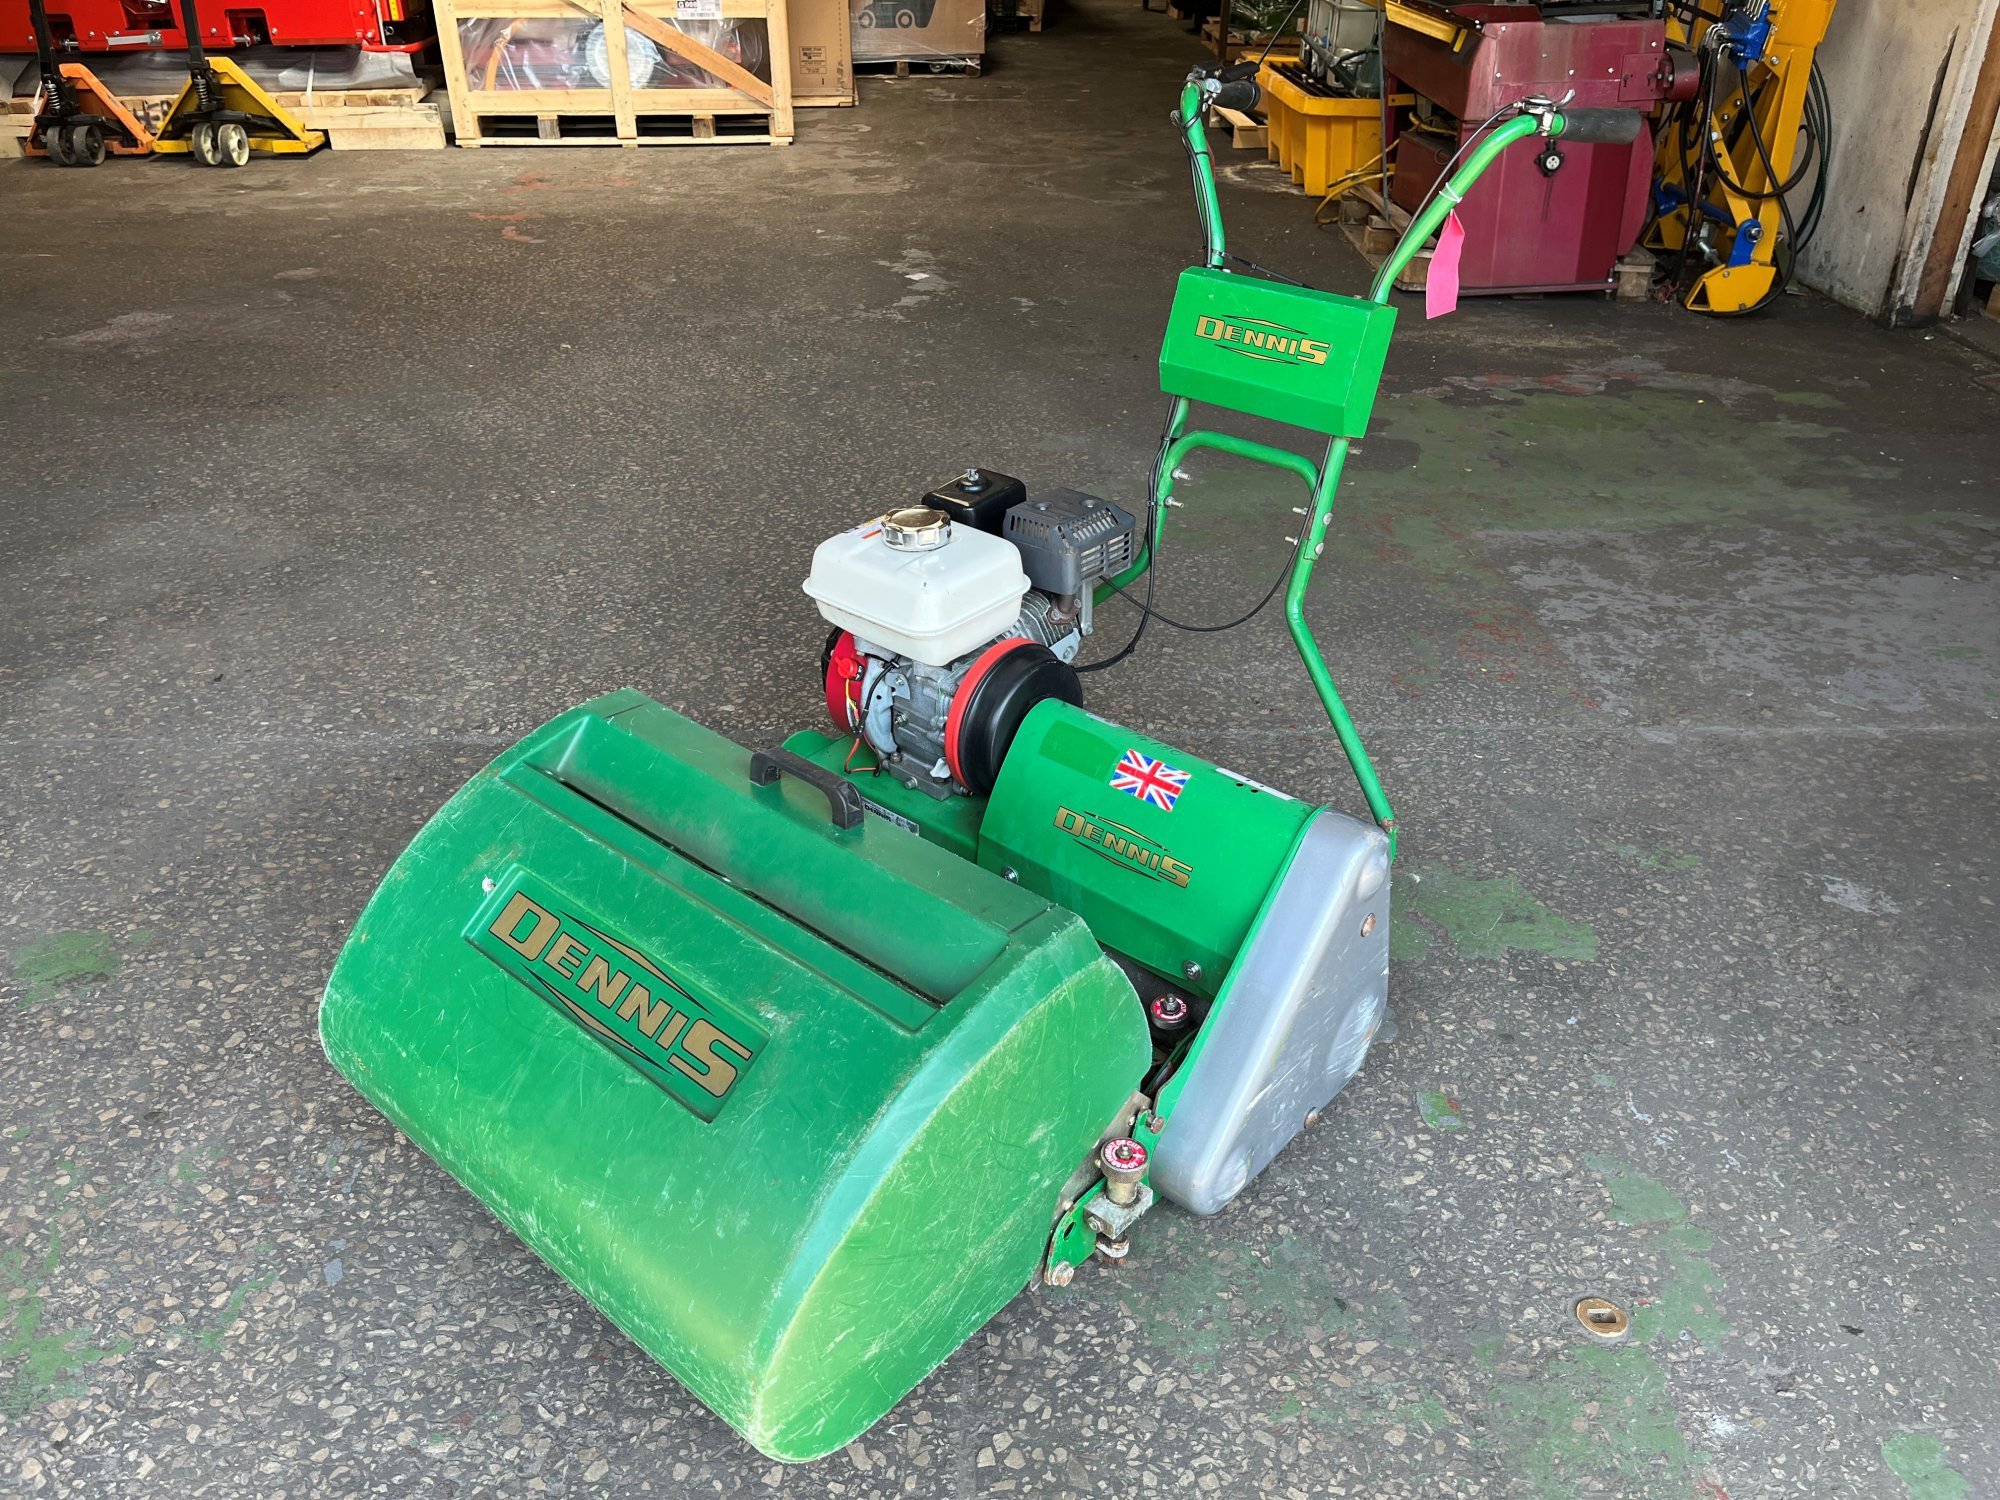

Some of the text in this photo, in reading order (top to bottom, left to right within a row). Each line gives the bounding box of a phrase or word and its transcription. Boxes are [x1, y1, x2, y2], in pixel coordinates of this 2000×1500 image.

[1195, 315, 1330, 365] DENNIS
[1053, 805, 1194, 889] DENNIS
[488, 890, 753, 1098] DENNIS
